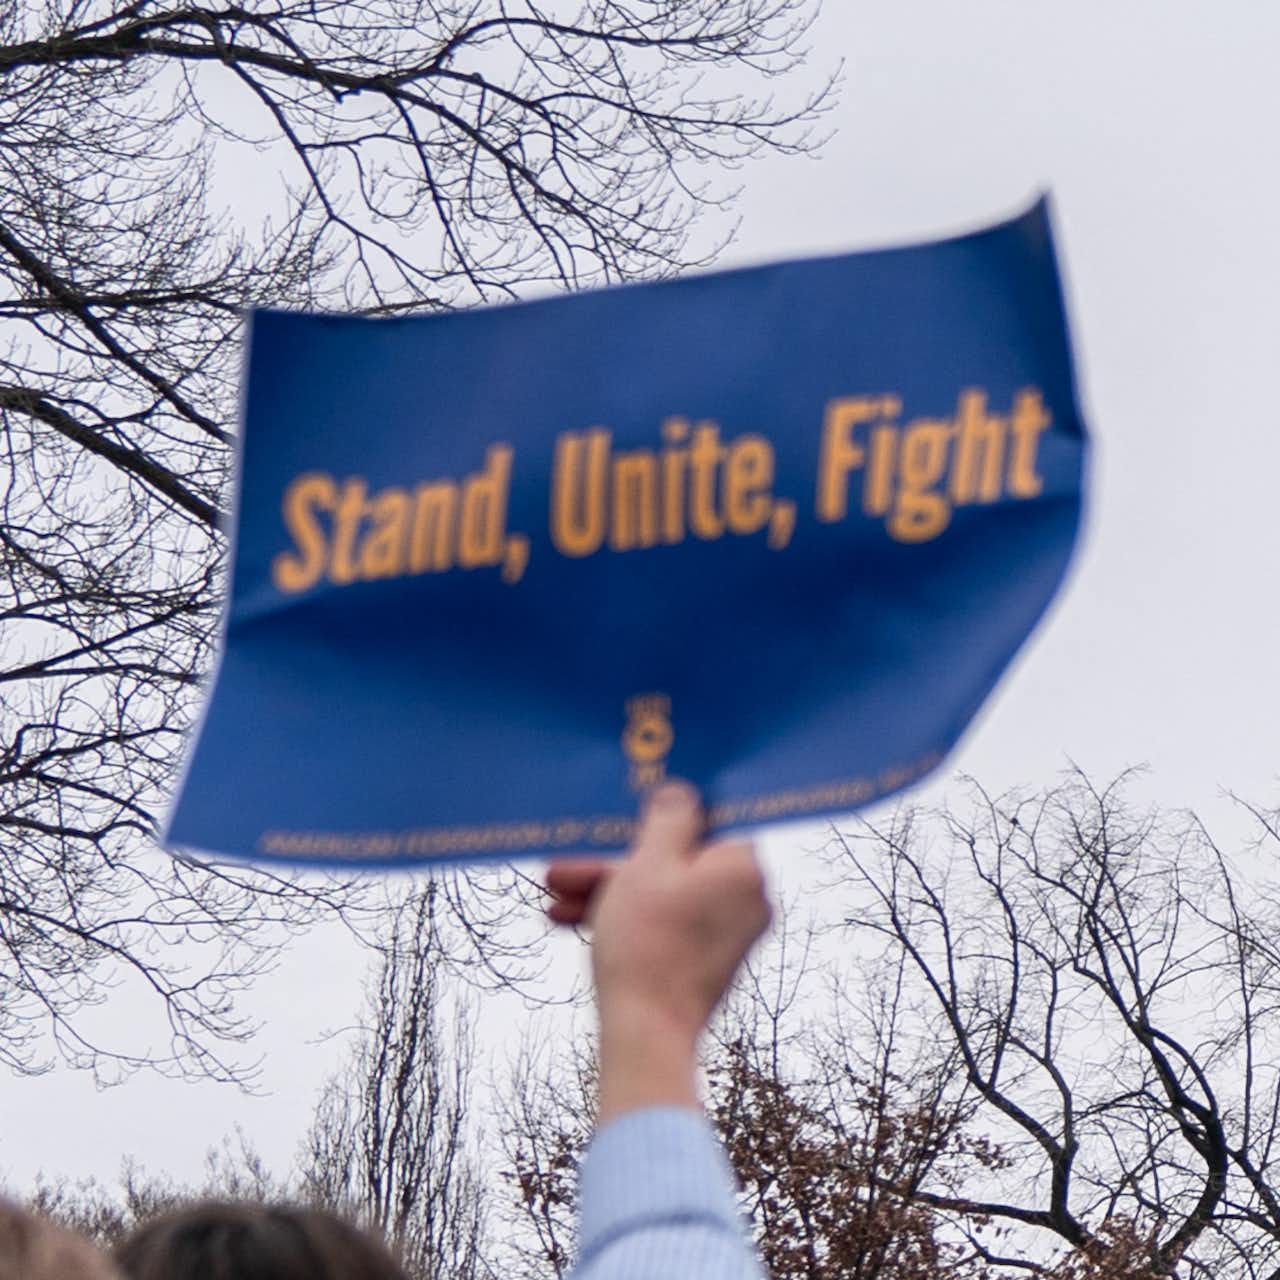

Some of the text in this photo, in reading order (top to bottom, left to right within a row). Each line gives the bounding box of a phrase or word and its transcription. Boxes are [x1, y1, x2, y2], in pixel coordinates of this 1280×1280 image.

[274, 386, 1051, 592] Stand, Unite, Fight
